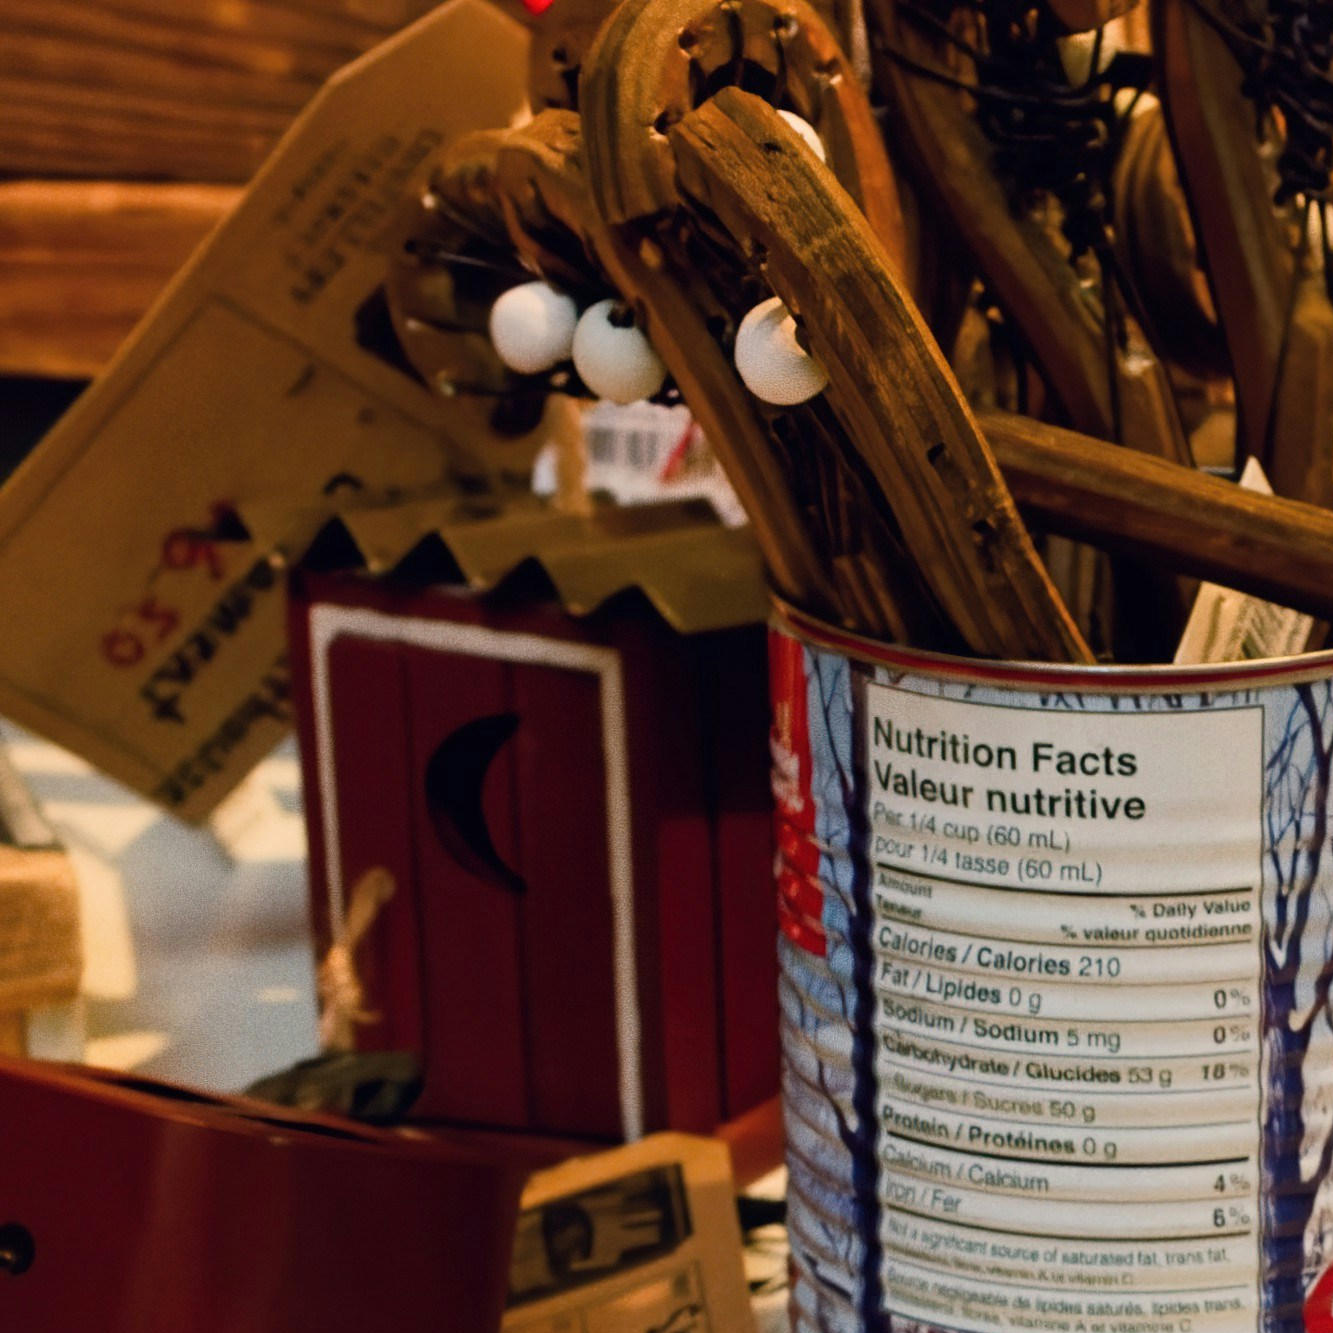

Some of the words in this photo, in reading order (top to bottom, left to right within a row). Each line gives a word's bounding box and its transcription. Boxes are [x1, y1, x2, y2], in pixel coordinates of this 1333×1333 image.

[873, 715, 1017, 771] Nutrition
[1032, 741, 1138, 777] Facts
[873, 759, 974, 809] Valeur
[986, 787, 1146, 820] nutritive
[909, 811, 937, 834] 1/4
[943, 822, 980, 844] cup
[986, 824, 1021, 848] (60
[1027, 830, 1071, 853] mL)
[874, 834, 915, 859] pour
[921, 842, 948, 865] 1/4
[955, 851, 1010, 876] tasse
[1017, 859, 1052, 882] (60
[1060, 862, 1103, 884] mL)
[1083, 924, 1140, 942] valeur
[1144, 921, 1252, 944] quotidienne
[1152, 901, 1197, 920] Daily
[1202, 899, 1251, 915] Value
[878, 925, 957, 963] Calories
[977, 945, 1072, 977] Calories
[1078, 955, 1122, 978] 210
[880, 960, 910, 987] Fat
[925, 971, 1003, 1005] Lipides
[1028, 992, 1043, 1015] g
[882, 996, 955, 1032] Sodium
[973, 1017, 1060, 1046] Sodium
[1086, 1031, 1122, 1053] mg
[1025, 1060, 1122, 1085] Glucides
[882, 1103, 950, 1139] Protein
[968, 1124, 1076, 1154] Protéines
[967, 1163, 1050, 1193] Calcium
